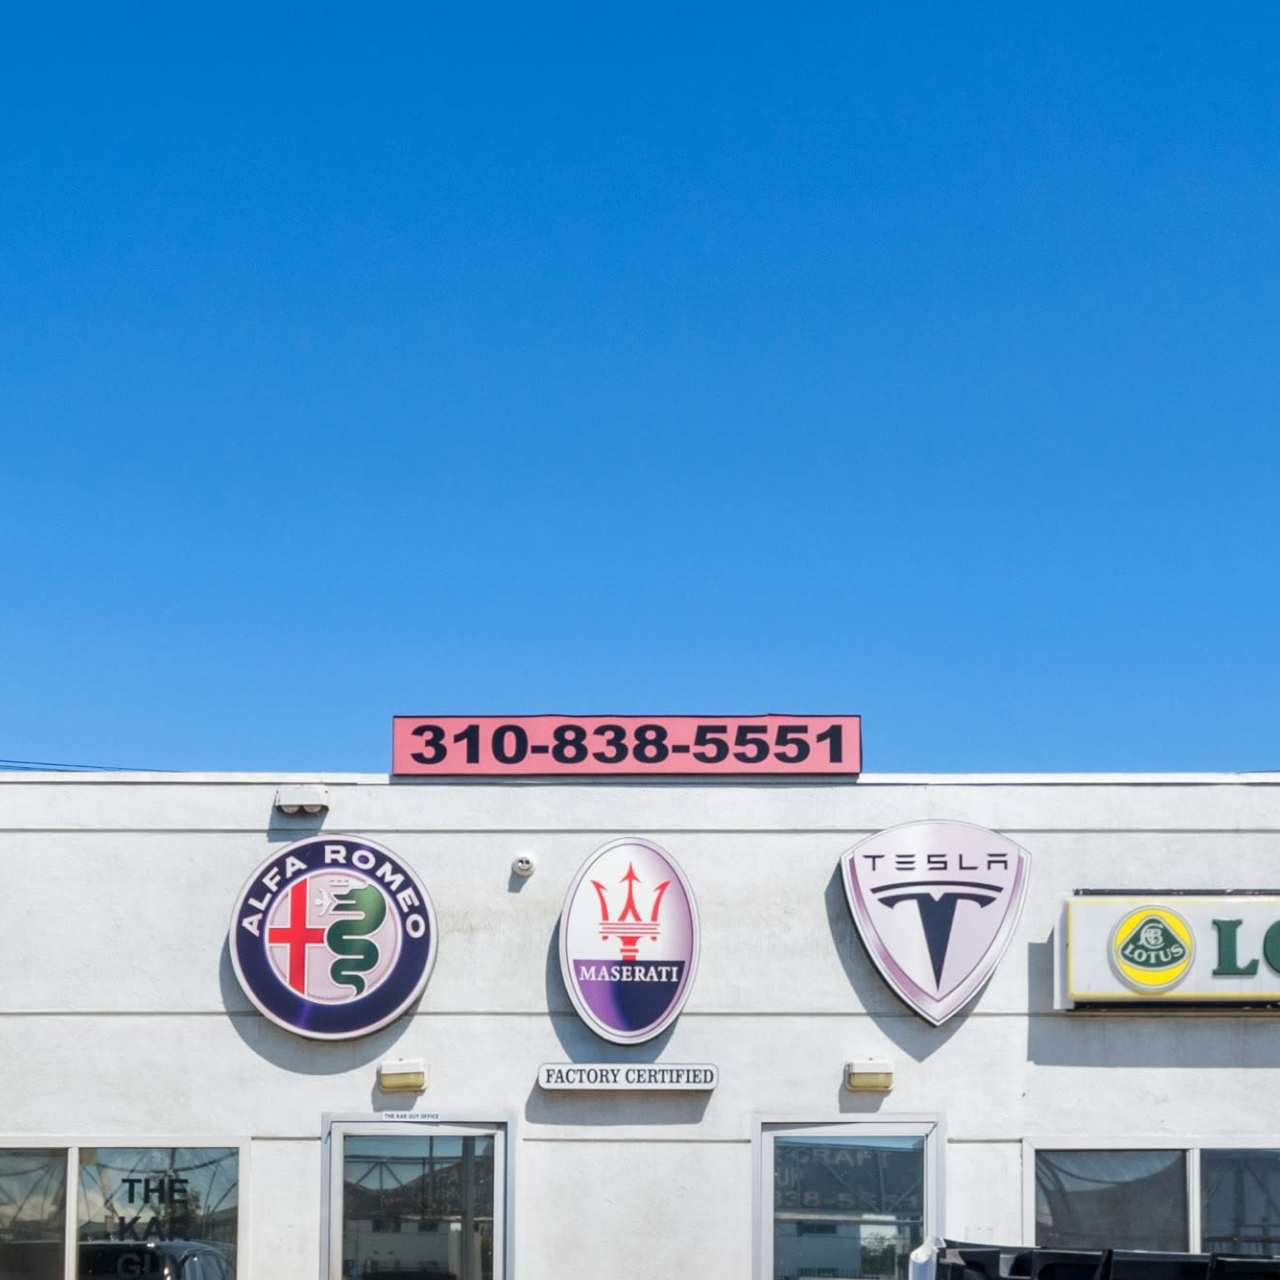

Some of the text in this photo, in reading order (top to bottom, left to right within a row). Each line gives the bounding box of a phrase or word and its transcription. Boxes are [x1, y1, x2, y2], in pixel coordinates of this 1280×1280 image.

[410, 723, 844, 765] 310-838-5551
[862, 853, 1008, 872] TESLA
[241, 845, 426, 939] ALFA ROMEO
[1123, 943, 1185, 964] LOTUS
[579, 966, 679, 982] MASERATI
[546, 1068, 715, 1084] FACTORY CERTIFIED
[121, 1177, 189, 1204] THE
